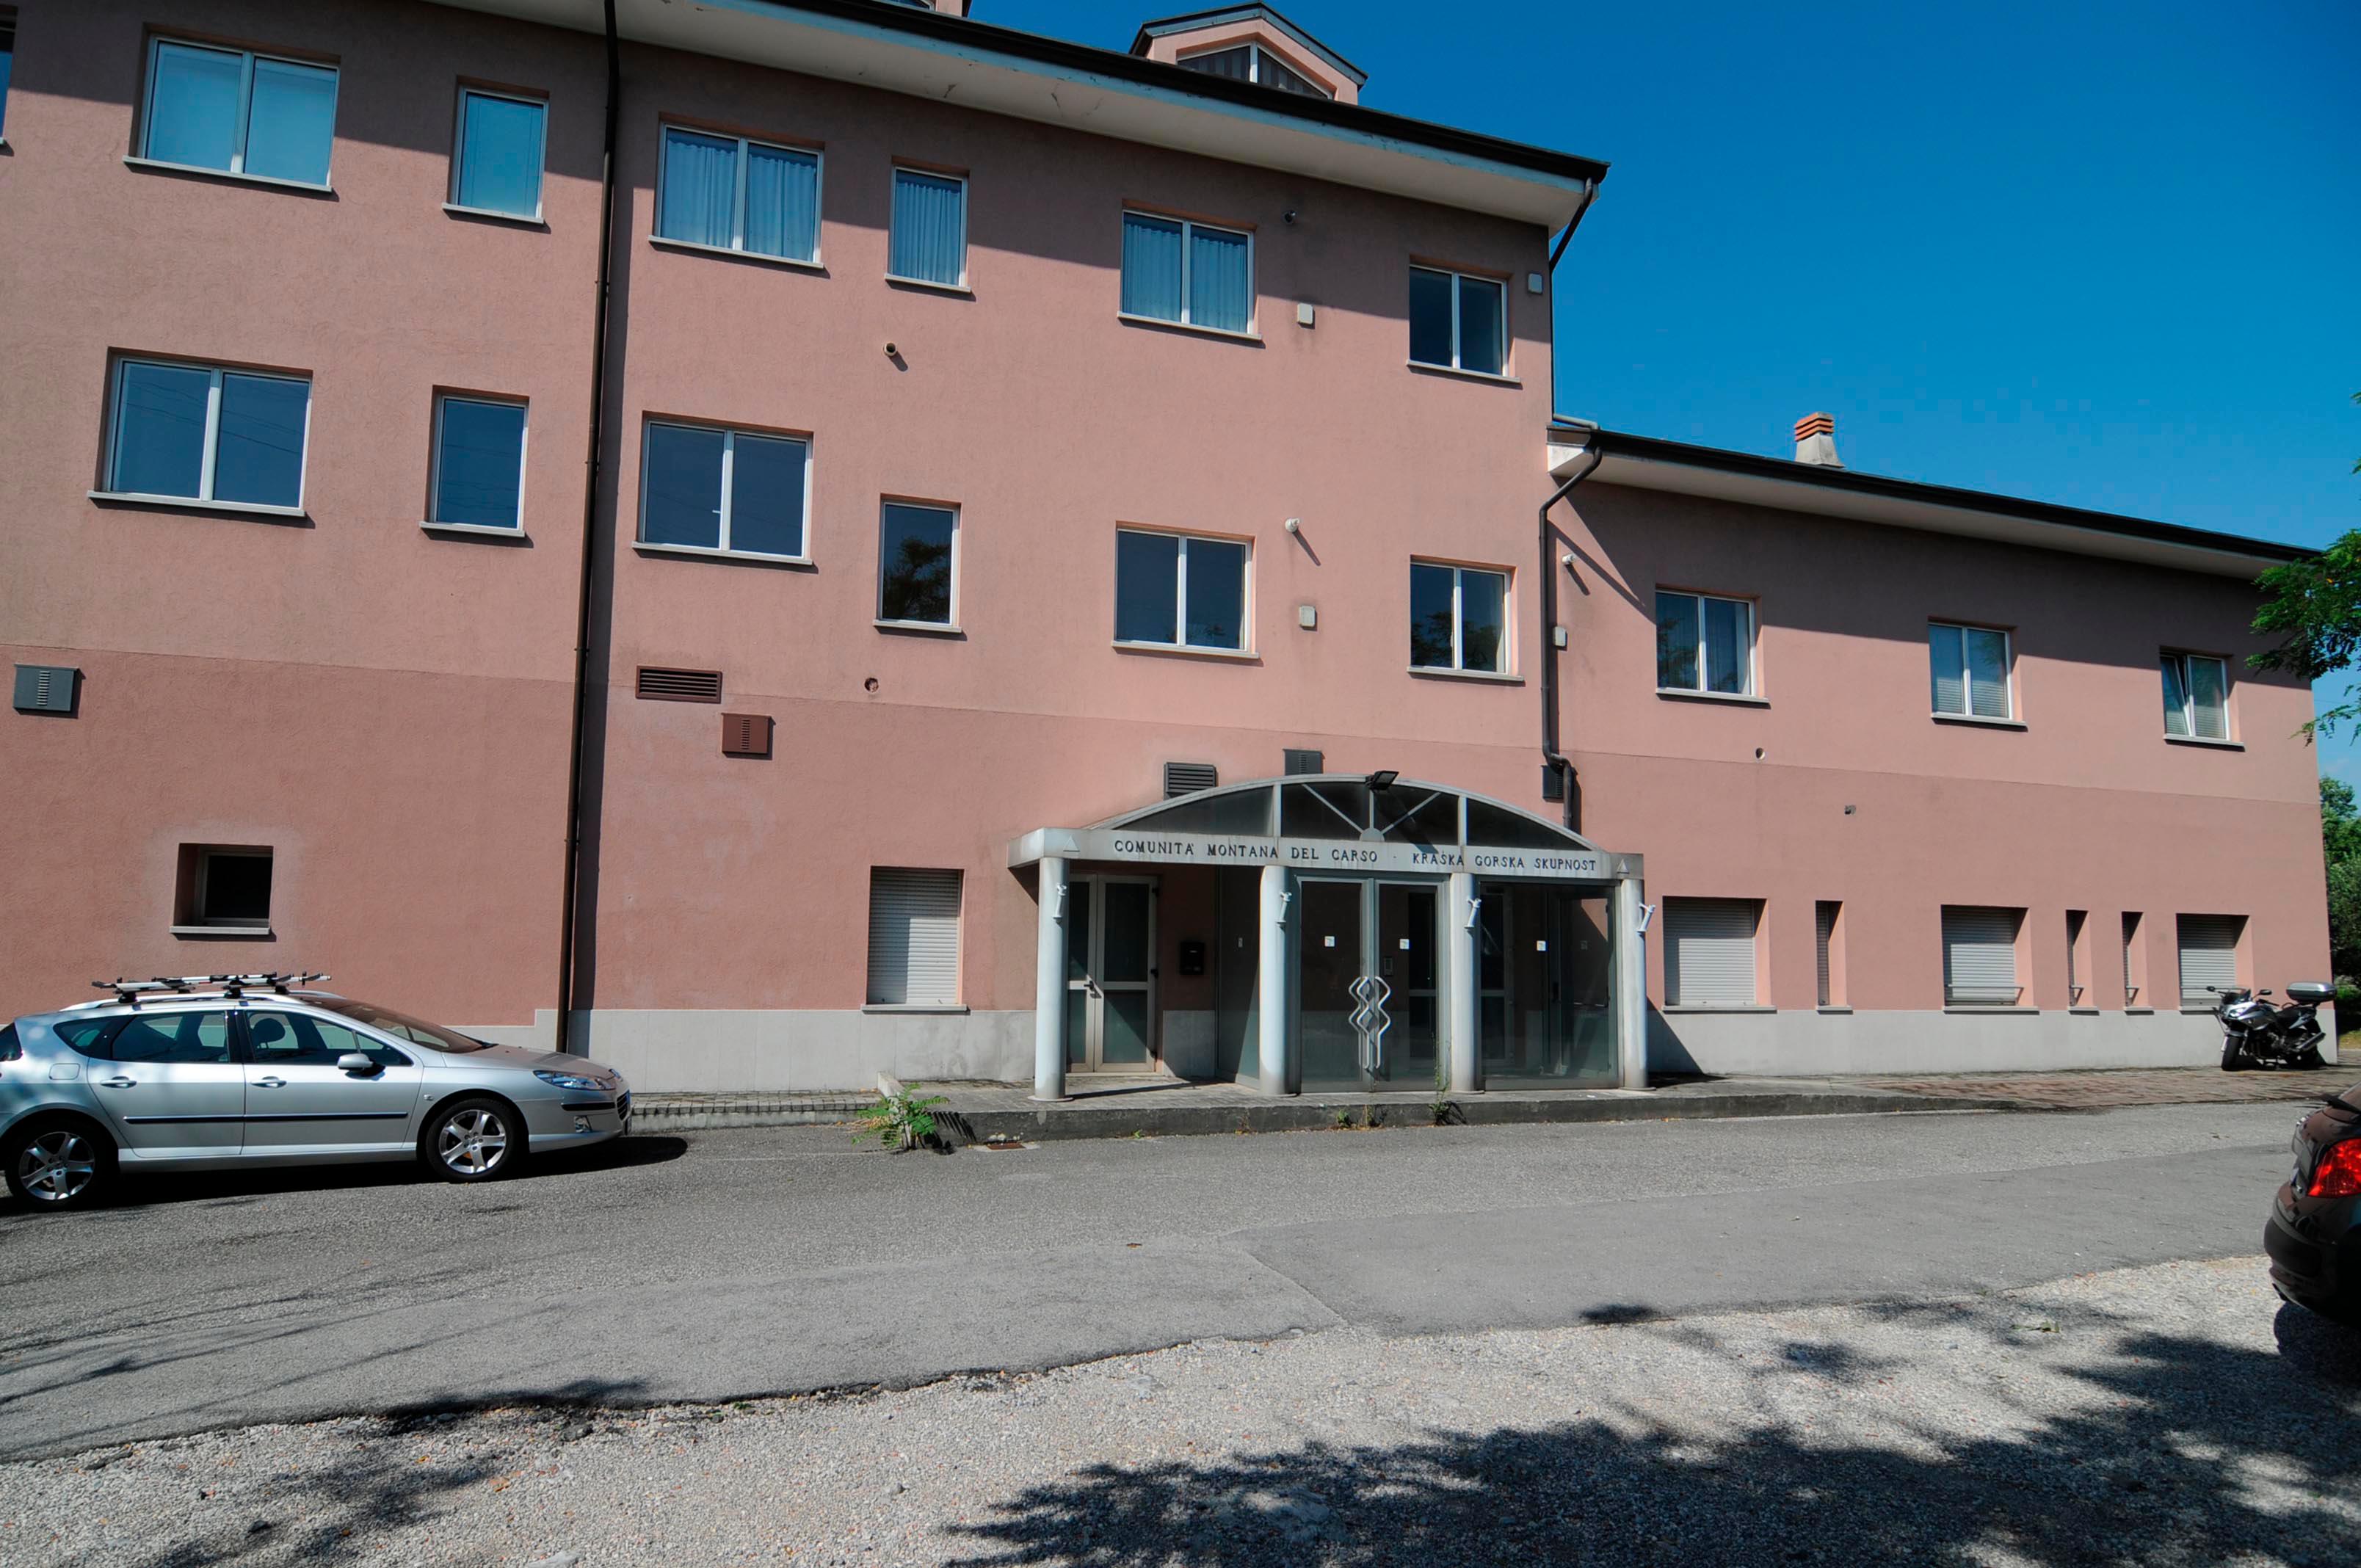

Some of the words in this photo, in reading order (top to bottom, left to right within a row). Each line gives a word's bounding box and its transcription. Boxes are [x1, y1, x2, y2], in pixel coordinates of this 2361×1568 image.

[1207, 843, 1278, 858] MONTANA
[1291, 847, 1319, 859] DEL
[1332, 849, 1377, 863] CARSO
[1475, 855, 1525, 868] GORSKA
[1534, 858, 1596, 871] SKUPNOST
